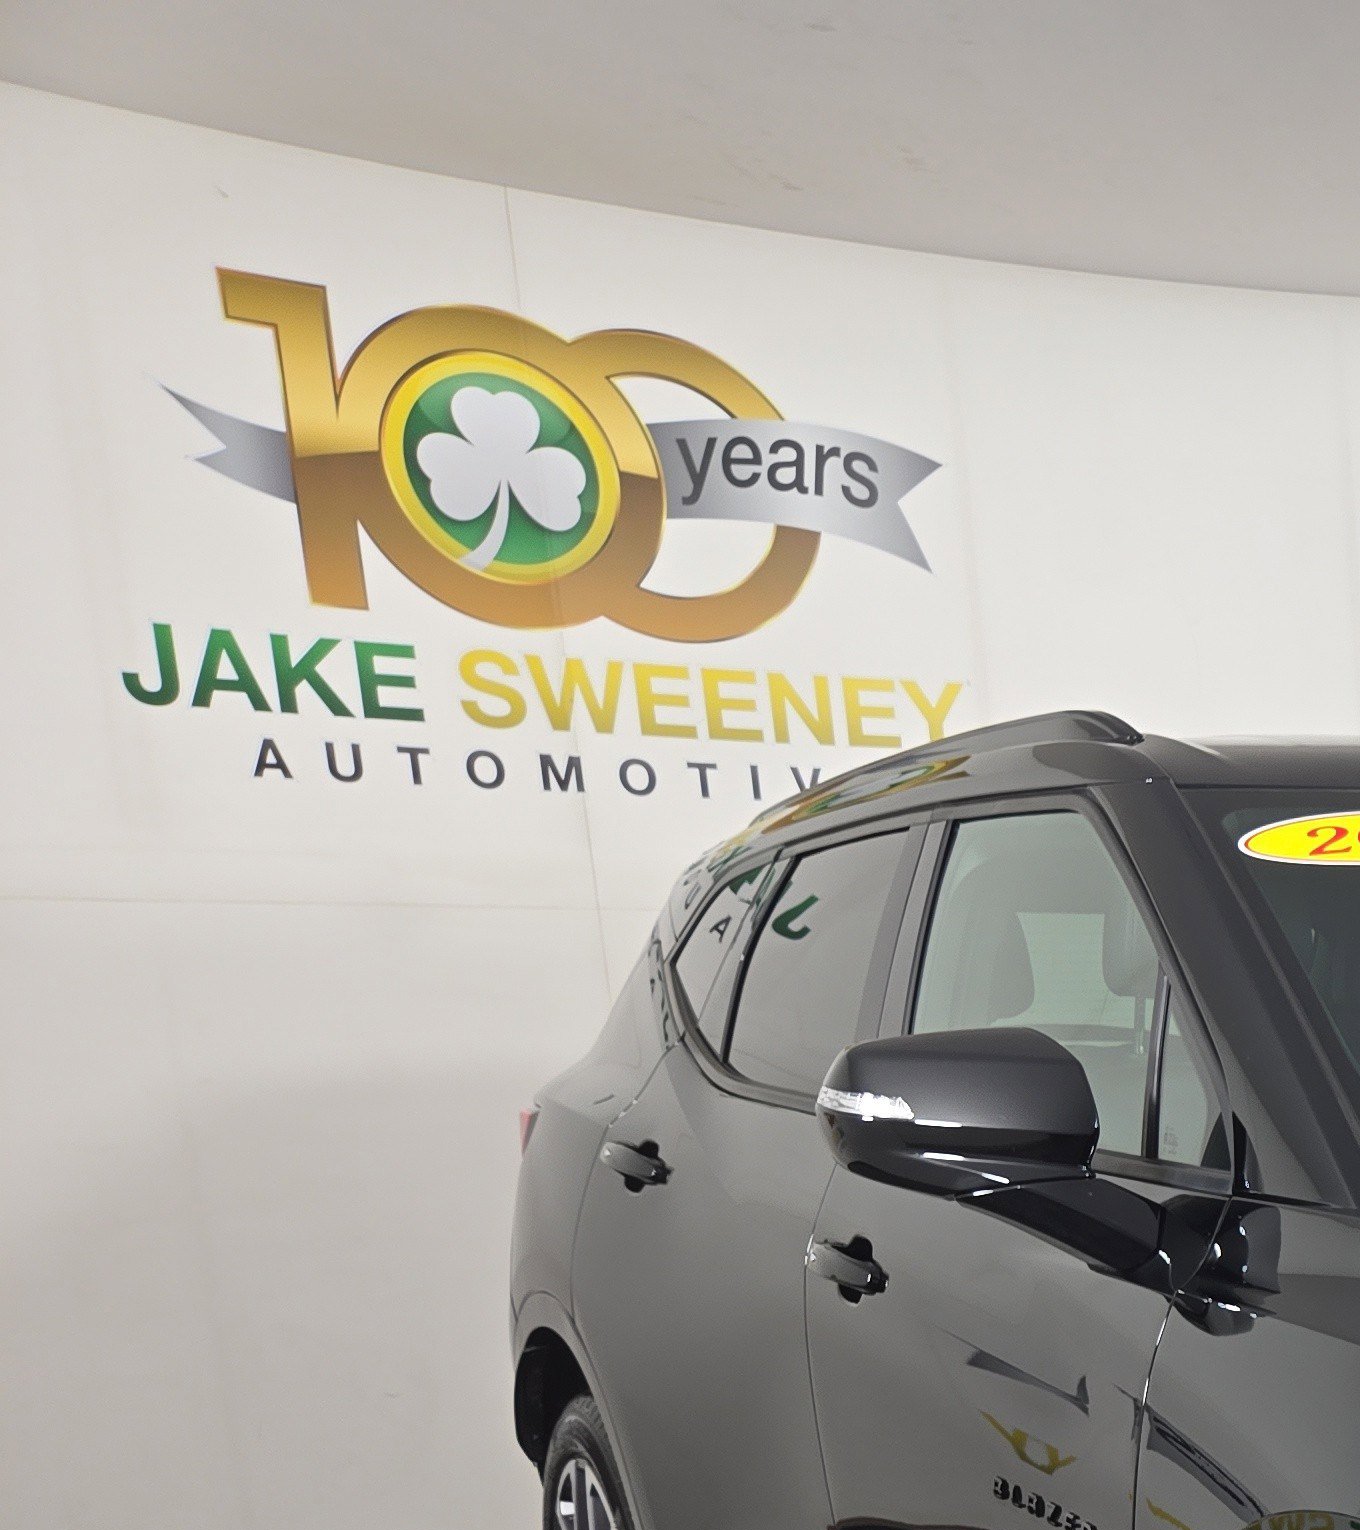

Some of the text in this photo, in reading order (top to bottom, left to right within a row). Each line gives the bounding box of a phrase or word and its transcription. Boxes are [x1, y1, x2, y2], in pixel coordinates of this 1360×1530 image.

[215, 267, 880, 643] 100 years
[122, 620, 963, 748] JAKE SWEENEY
[253, 738, 822, 800] AUTOMOTIV
